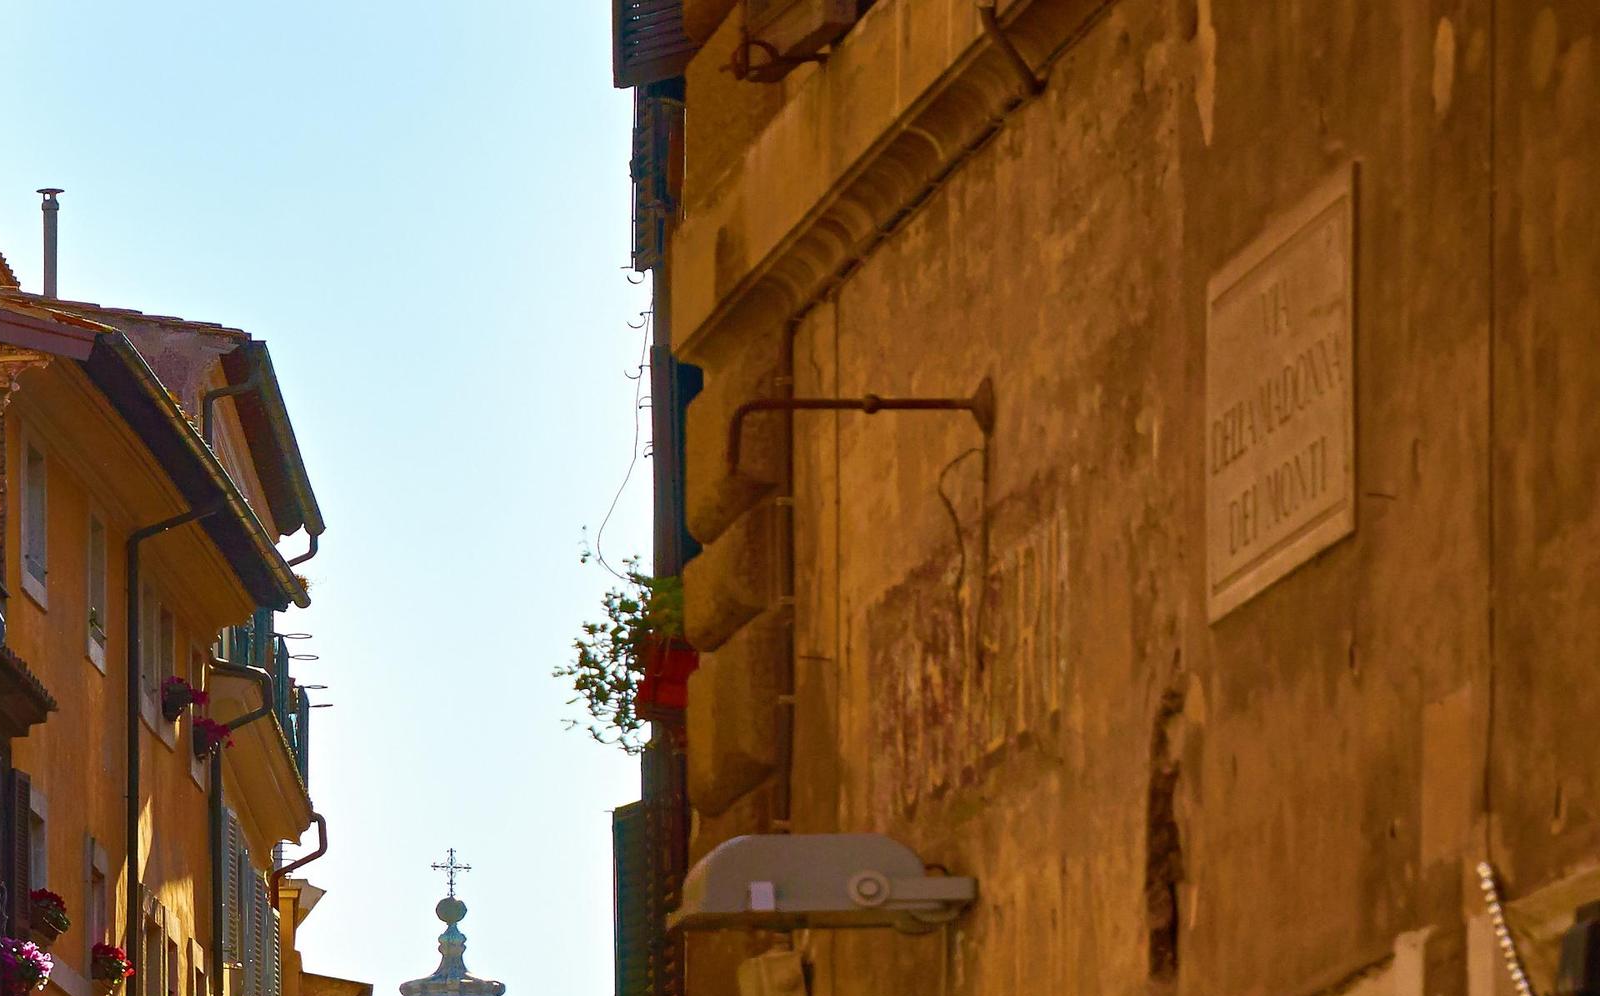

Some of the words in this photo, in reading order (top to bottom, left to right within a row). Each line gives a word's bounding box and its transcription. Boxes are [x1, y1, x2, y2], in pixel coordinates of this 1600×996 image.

[1261, 277, 1291, 336] VIA
[1211, 398, 1258, 477] DELLA
[1259, 330, 1344, 435] MADONNA
[1228, 482, 1259, 557] DEI
[1266, 434, 1328, 531] MONTI
